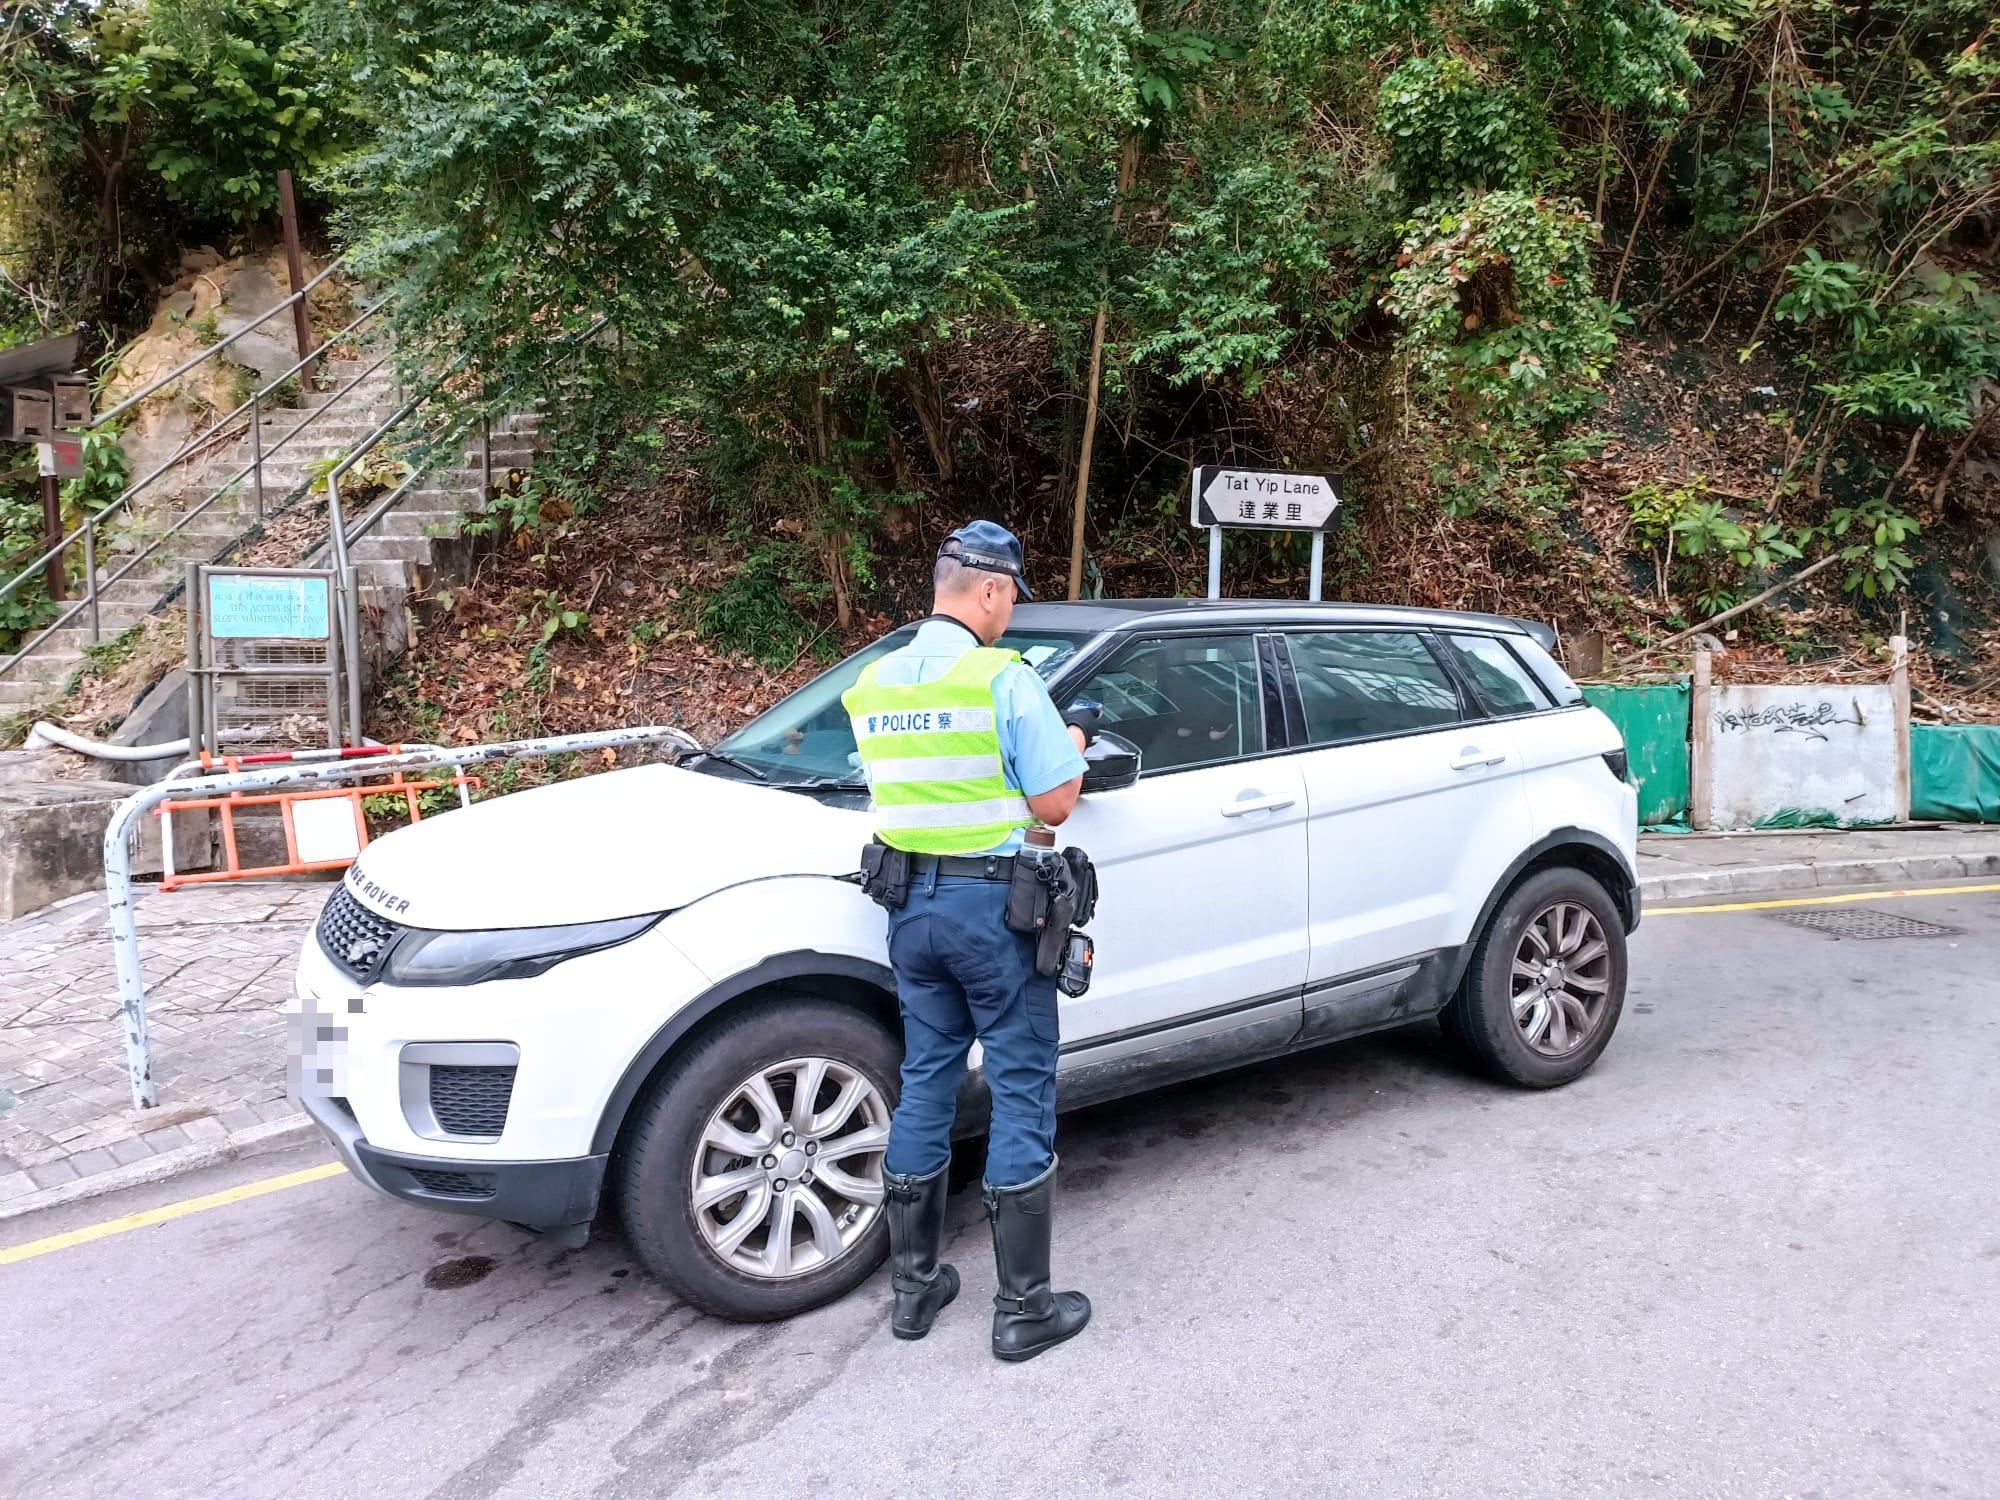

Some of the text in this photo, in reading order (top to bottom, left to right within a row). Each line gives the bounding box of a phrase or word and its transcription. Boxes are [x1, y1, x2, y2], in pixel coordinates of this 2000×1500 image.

[1224, 475, 1320, 496] Tat Yip Lane
[1238, 500, 1302, 521] 達業里
[250, 603, 281, 613] ACCESS
[293, 604, 309, 613] FR
[881, 713, 931, 731] POLICE
[937, 712, 952, 729] 察
[362, 881, 411, 915] ROVER
